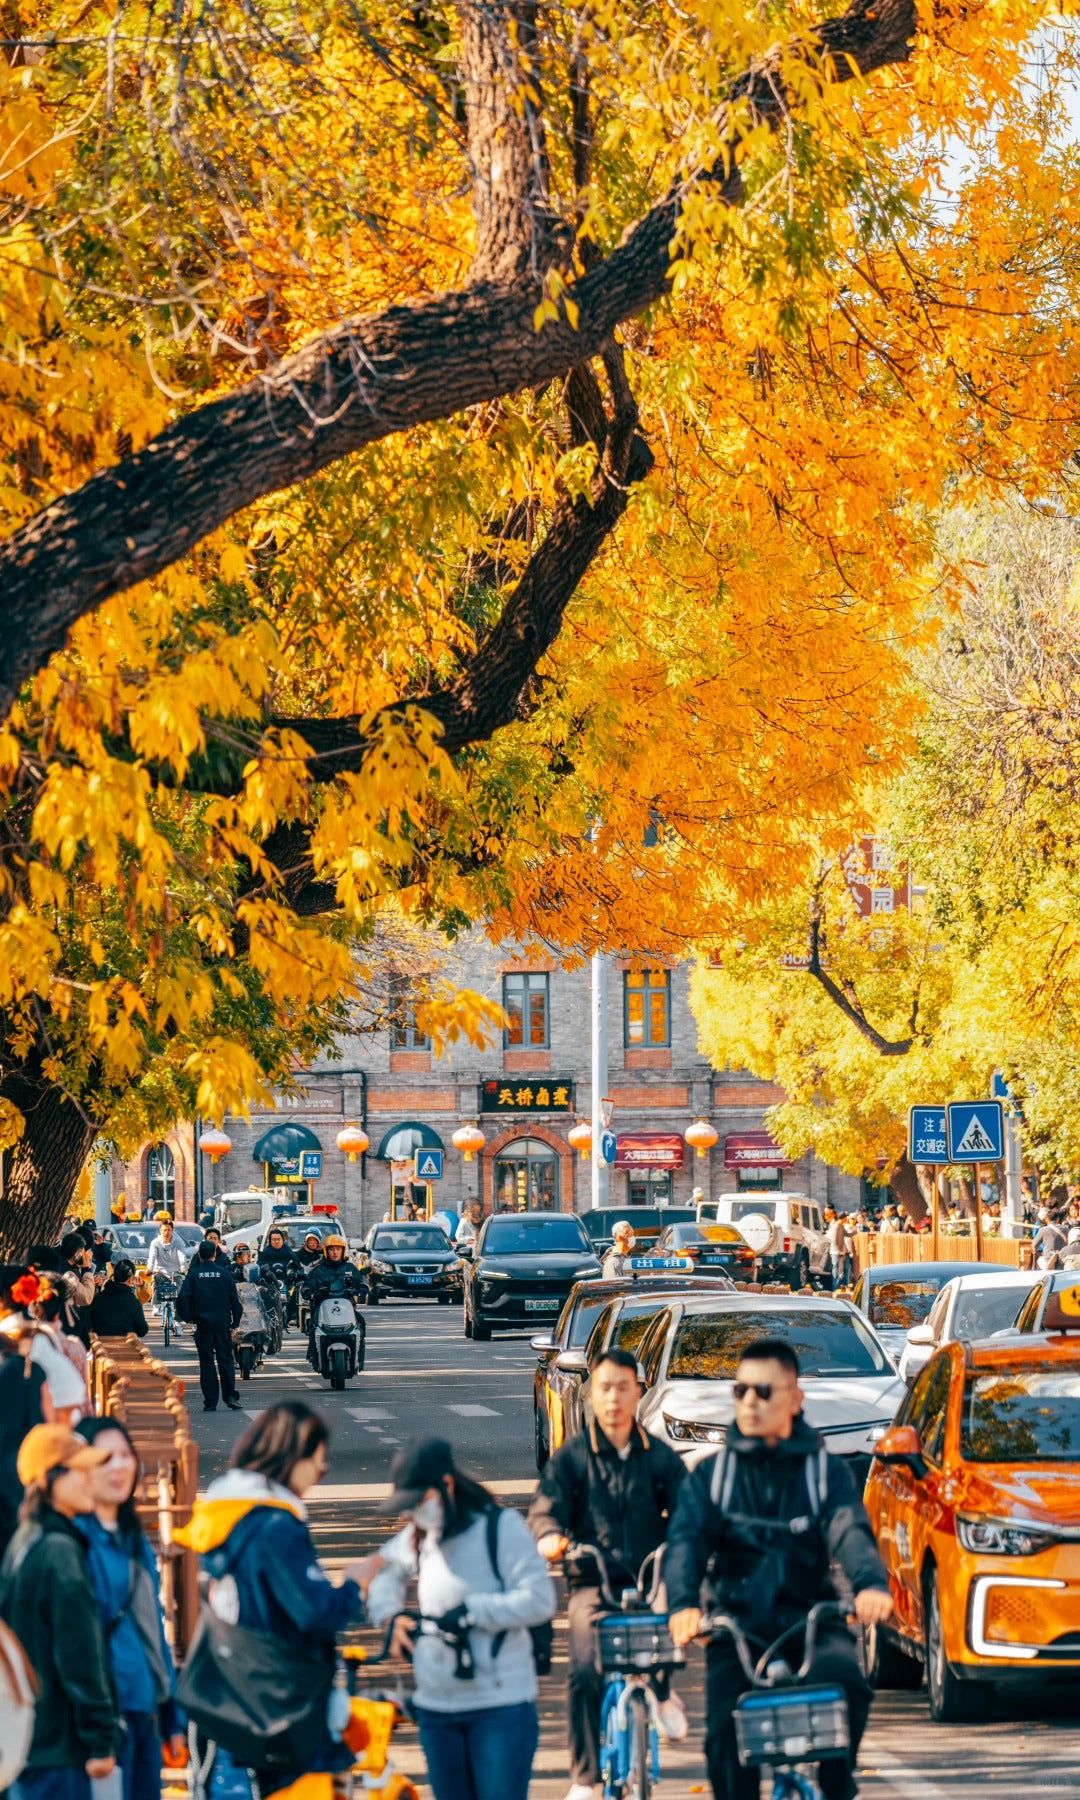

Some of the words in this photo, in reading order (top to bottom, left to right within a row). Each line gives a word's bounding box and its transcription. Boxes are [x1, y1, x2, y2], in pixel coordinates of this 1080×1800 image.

[497, 1087, 569, 1106] 天桥卤煮
[637, 1259, 681, 1268] 出租
